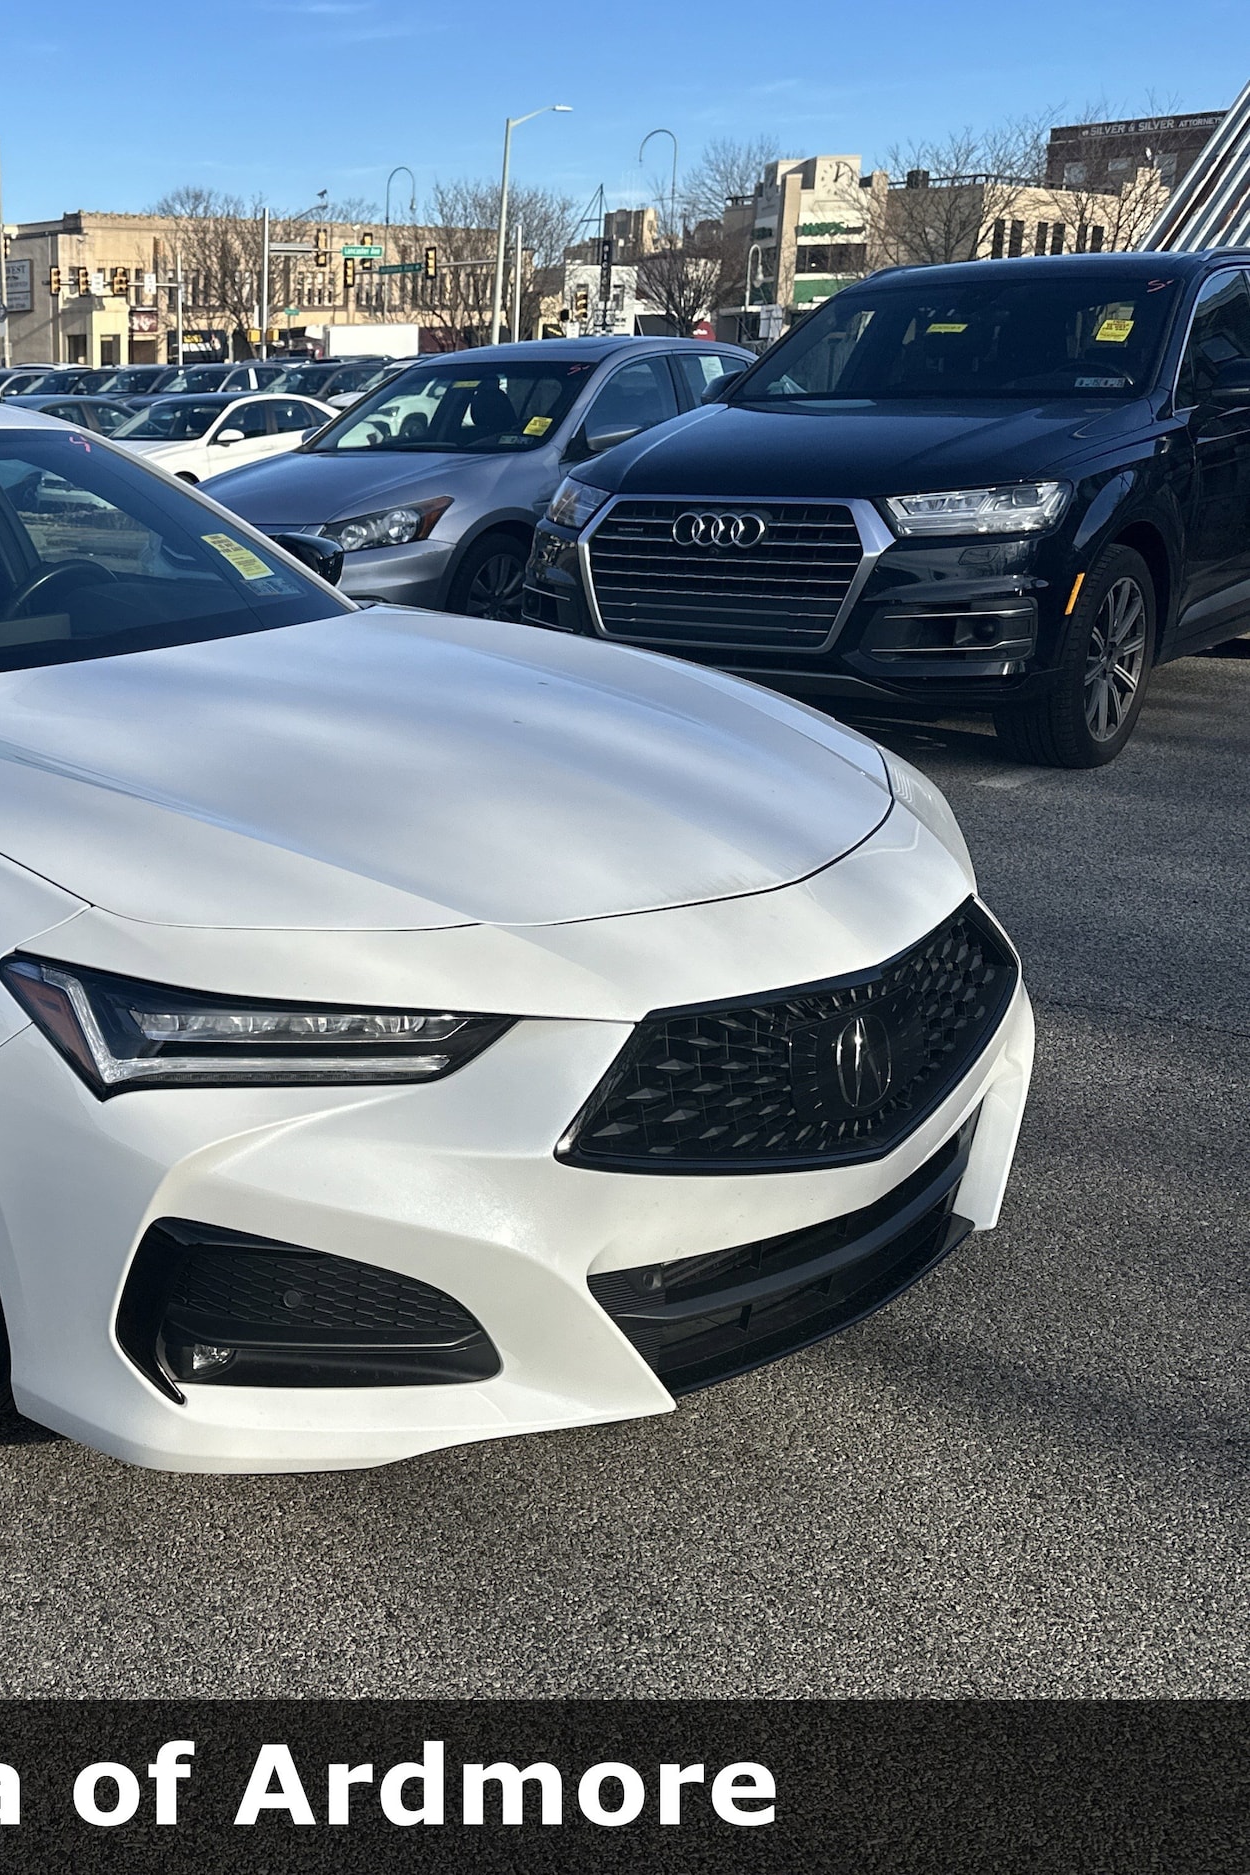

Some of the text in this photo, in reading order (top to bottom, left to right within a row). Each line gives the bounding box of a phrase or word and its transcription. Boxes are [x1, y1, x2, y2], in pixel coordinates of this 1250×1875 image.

[1090, 124, 1126, 137] SILVER
[1128, 124, 1135, 133] &
[1138, 120, 1175, 132] SILVER
